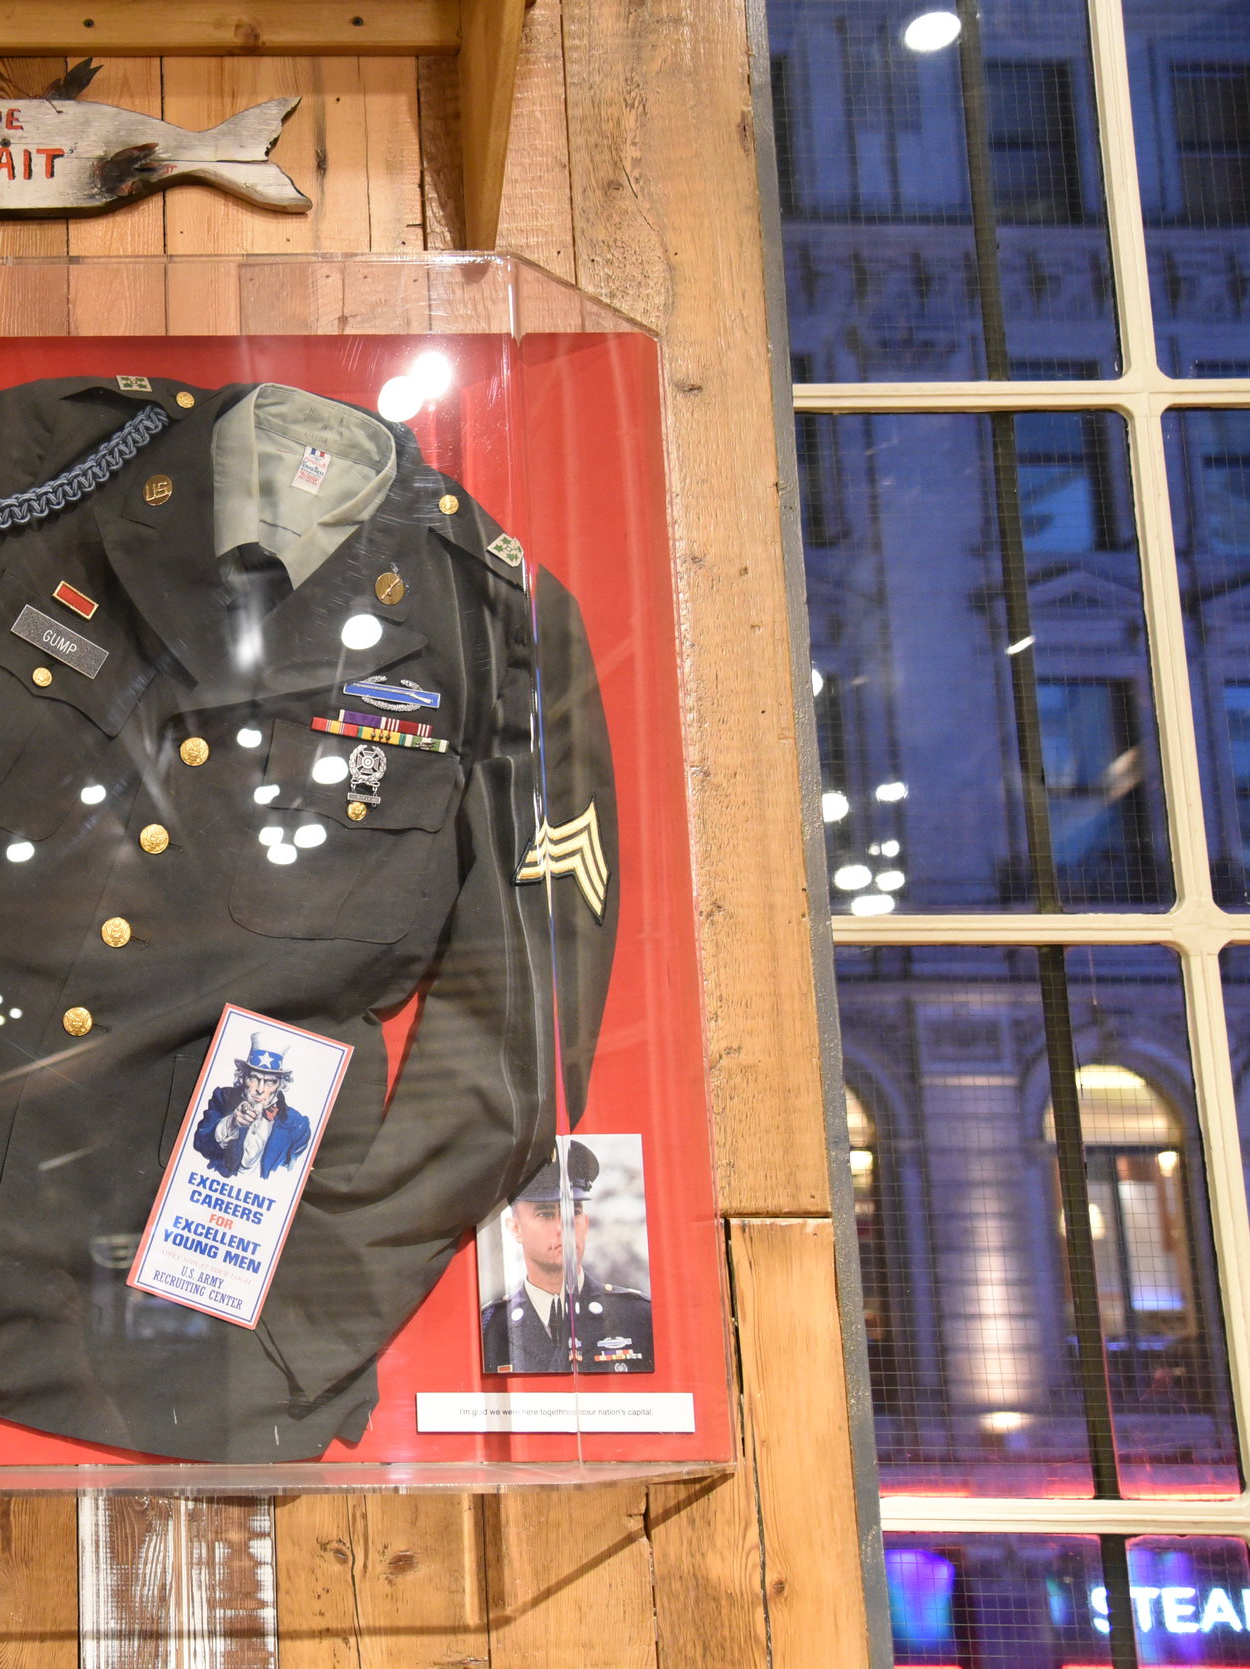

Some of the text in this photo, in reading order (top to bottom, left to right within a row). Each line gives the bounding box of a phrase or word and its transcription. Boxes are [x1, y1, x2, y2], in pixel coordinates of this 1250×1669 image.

[145, 482, 171, 501] US
[42, 629, 77, 655] GUMP
[188, 1171, 277, 1212] EXCELLENT
[189, 1189, 264, 1225] CAREERS
[173, 1215, 261, 1256] EXCELLENT
[208, 1213, 234, 1230] FOR
[163, 1228, 262, 1274] YOUNG MEN
[153, 1269, 243, 1310] RECRUITING CENTER
[181, 1265, 225, 1290] U.S. ARMY
